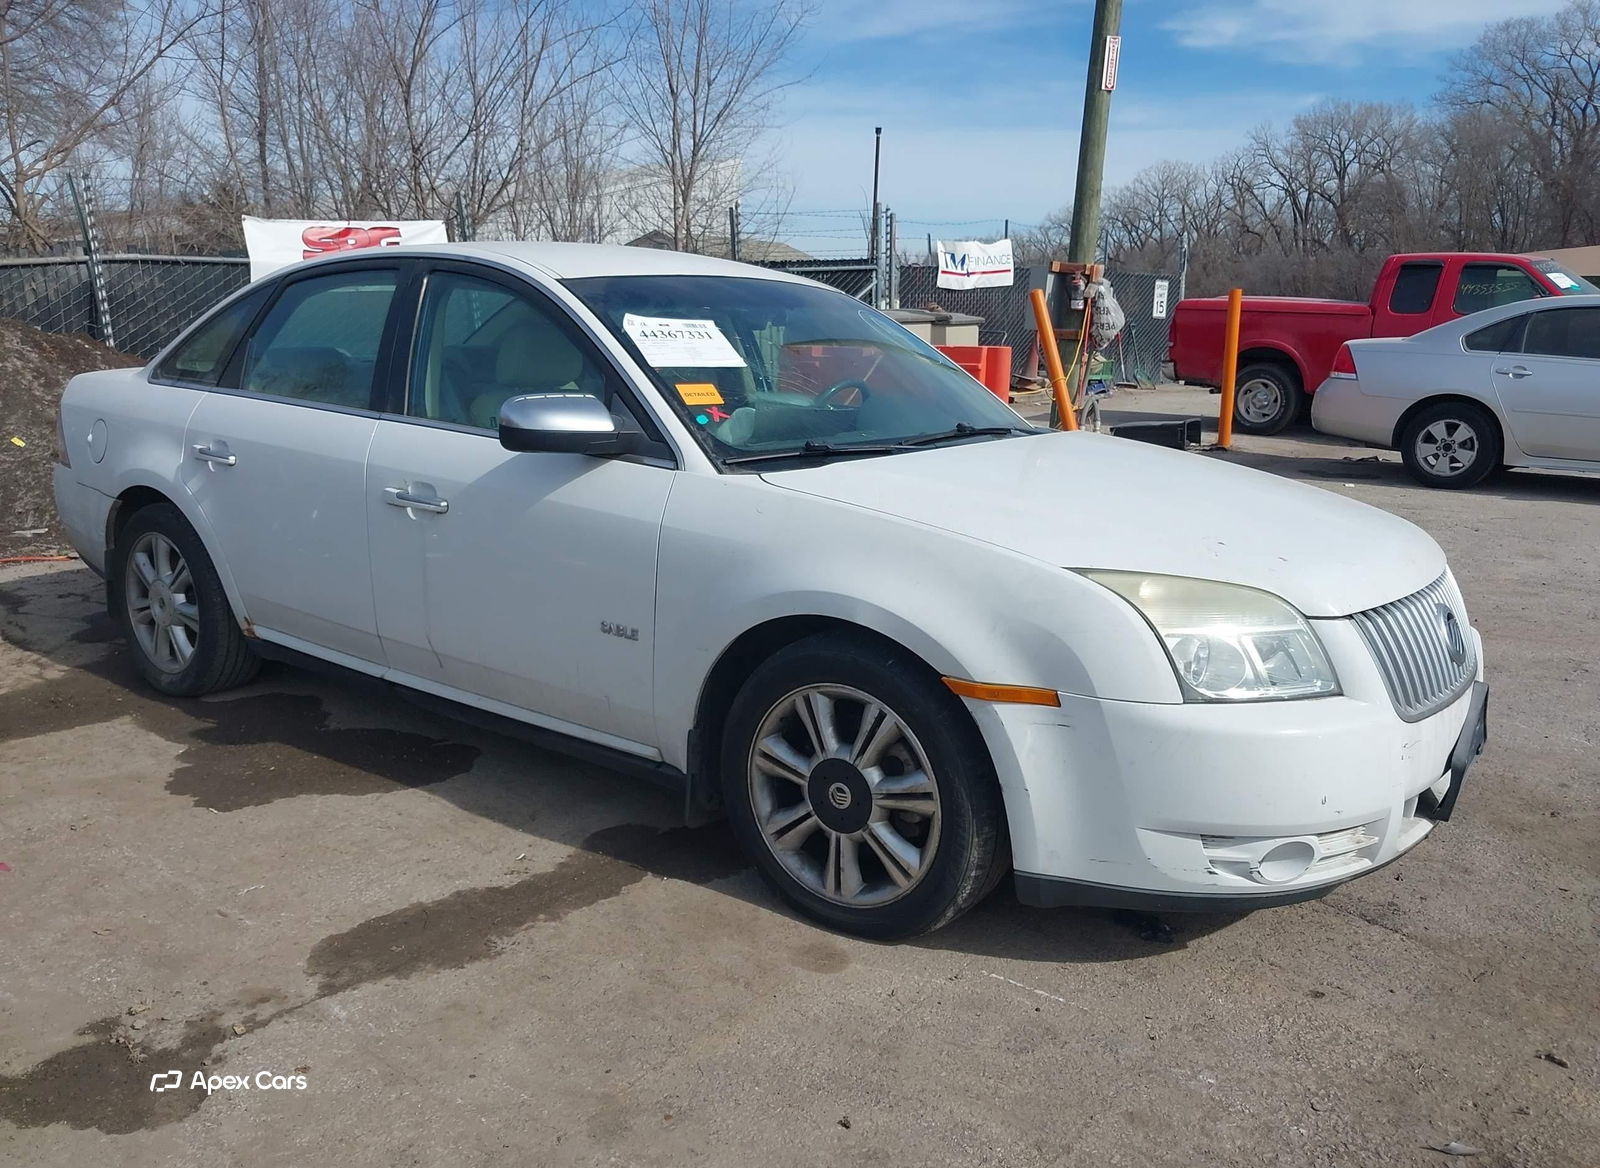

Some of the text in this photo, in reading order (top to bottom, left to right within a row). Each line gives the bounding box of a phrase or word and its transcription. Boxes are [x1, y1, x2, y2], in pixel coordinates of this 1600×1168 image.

[968, 254, 1011, 266] FINANCE
[1156, 301, 1164, 313] 15
[640, 330, 713, 339] 44367331
[601, 620, 639, 641] SABLE
